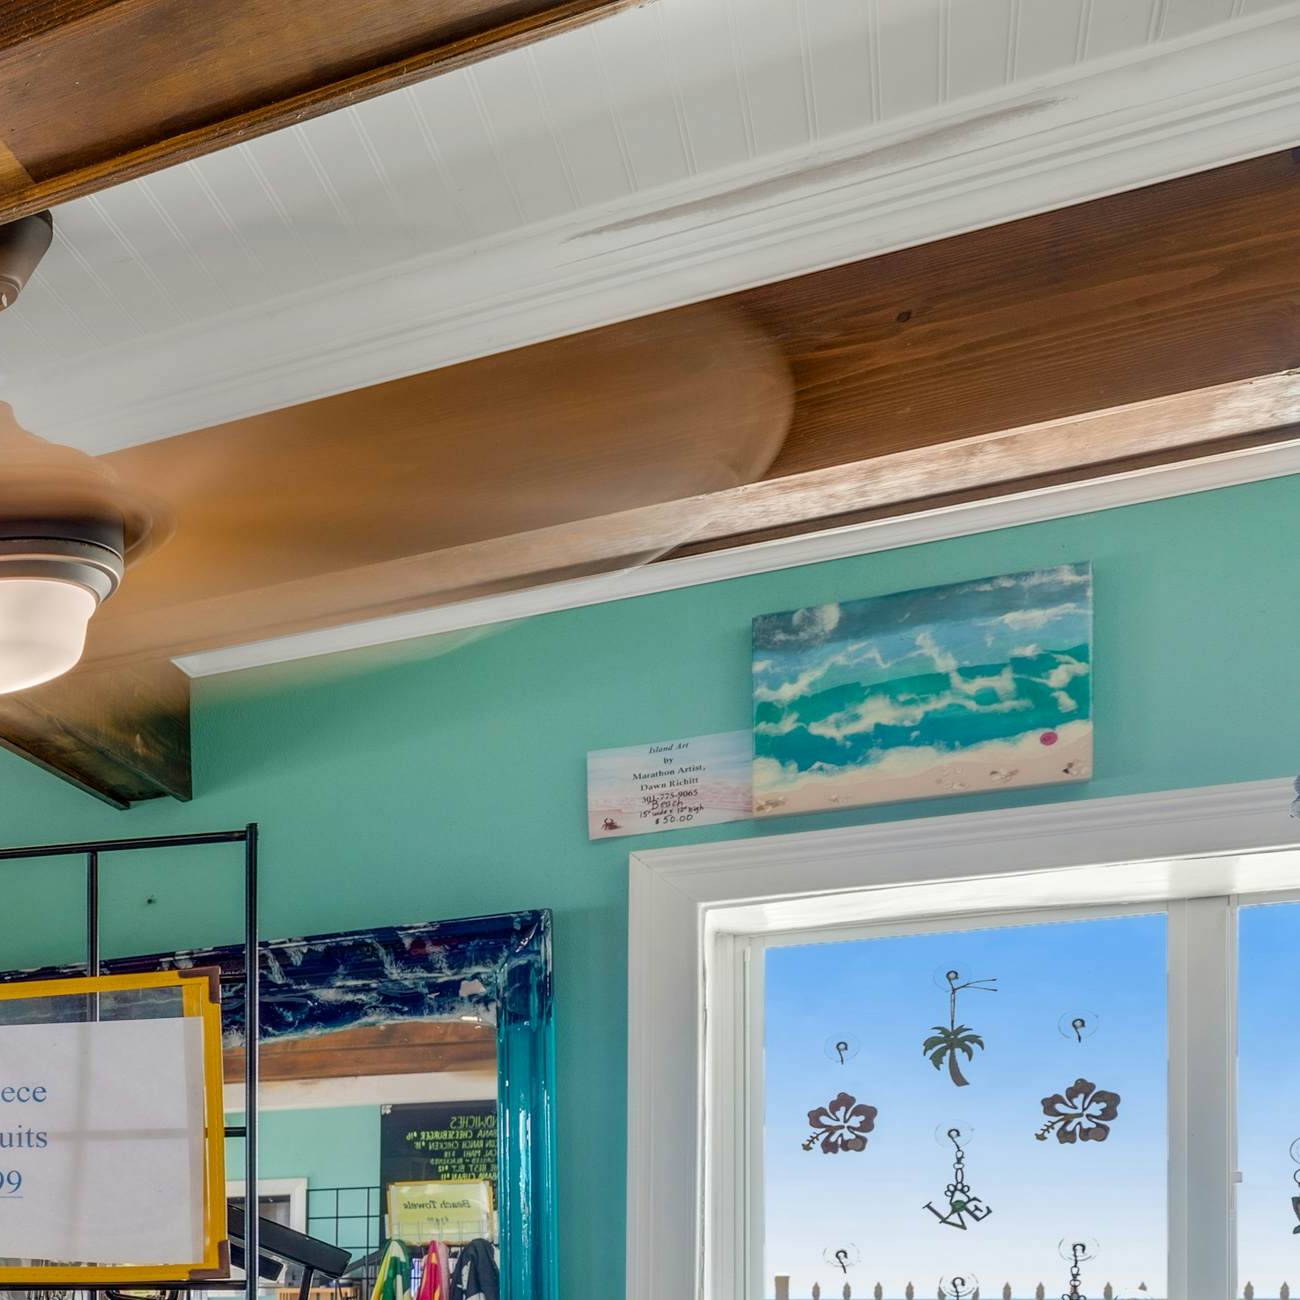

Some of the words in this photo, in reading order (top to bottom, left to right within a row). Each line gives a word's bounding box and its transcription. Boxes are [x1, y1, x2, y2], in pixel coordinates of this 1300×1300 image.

[648, 743, 674, 754] Island
[675, 742, 690, 751] Art
[663, 757, 673, 765] by
[632, 769, 675, 781] Marathon
[640, 781, 667, 792] Dawn
